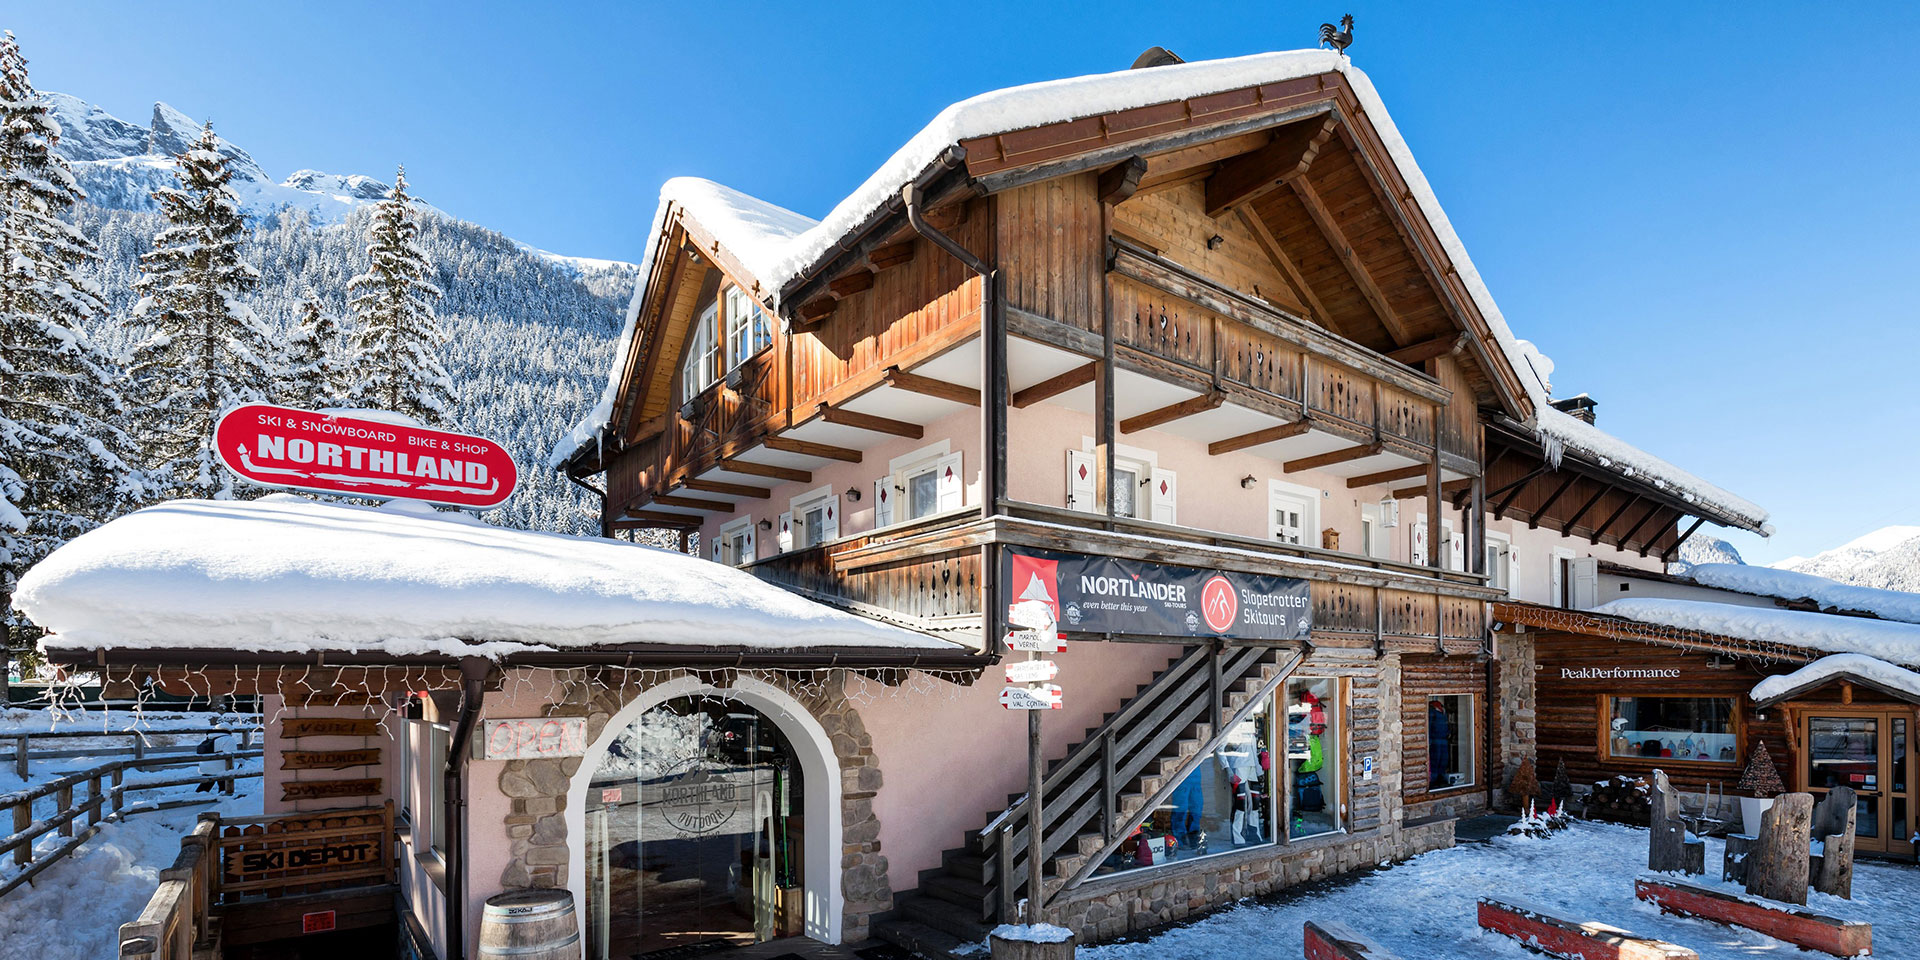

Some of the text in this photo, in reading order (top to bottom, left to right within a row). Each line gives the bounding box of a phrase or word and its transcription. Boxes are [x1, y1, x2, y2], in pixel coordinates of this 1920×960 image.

[258, 414, 488, 455] SKI & SNOWBOARD BIKE & SHOP
[257, 433, 488, 485] NORTHLAND
[1081, 575, 1187, 602] NORTLANDER
[1241, 588, 1308, 609] Slopetrotter
[1082, 600, 1148, 614] even better this year
[1164, 601, 1187, 609] SKI-TOURS
[1243, 608, 1286, 626] Skitours
[490, 721, 583, 756] OPEN
[662, 783, 736, 805] NORTHLAND
[678, 808, 725, 829] OUTDOOR
[242, 844, 370, 872] SKI DEPOT
